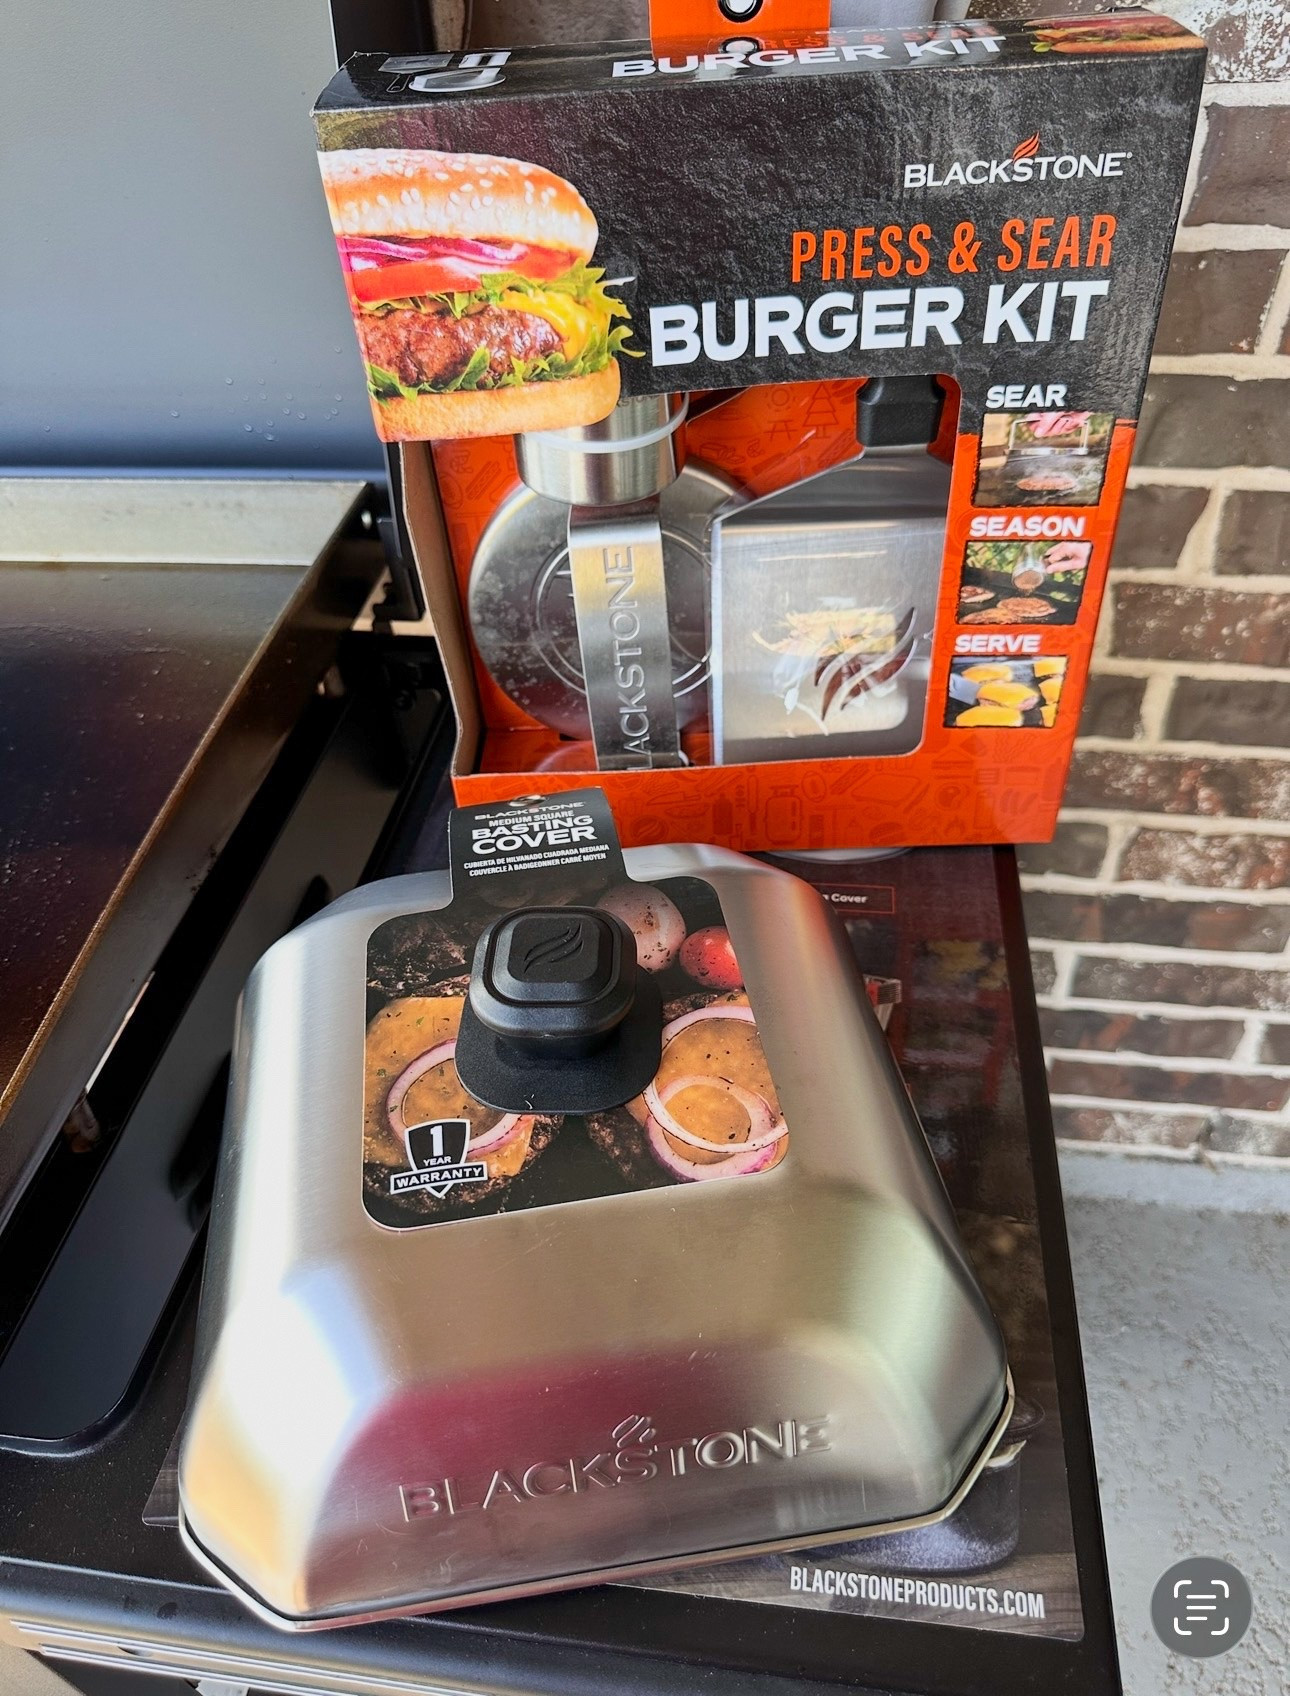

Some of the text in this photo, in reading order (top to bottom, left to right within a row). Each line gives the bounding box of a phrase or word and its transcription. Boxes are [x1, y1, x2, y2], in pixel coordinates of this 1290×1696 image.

[611, 35, 1007, 78] BURGER KIT
[903, 151, 1128, 189] BLACKSTONE
[791, 213, 1118, 283] PRESS & SEAR
[647, 279, 1111, 367] BURGER KIT
[985, 384, 1068, 409] SEAR
[969, 515, 1086, 538] SEASON
[954, 633, 1042, 653] SERVE
[602, 545, 653, 770] LACKSTONE
[474, 801, 584, 821] BLACKSTONE
[488, 810, 575, 828] MEDIUM SQUARE
[471, 814, 594, 840] BASTING
[471, 826, 598, 855] COVER
[463, 859, 496, 869] CUBIERTA
[505, 852, 543, 864] HILVANADO
[543, 849, 579, 858] CUADRADA
[579, 844, 610, 854] MEDIANA
[469, 866, 508, 877] COUVERCLE
[513, 859, 561, 871] BADIGEONNER
[560, 855, 582, 865] CARRÉ
[583, 853, 607, 862] MOYEN
[831, 893, 869, 904] Cover
[430, 1124, 444, 1157] 1
[423, 1155, 452, 1167] YEAR
[395, 1167, 482, 1189] WARRANTY
[398, 1414, 834, 1523] BLACKSTONE
[789, 1565, 1047, 1619] BLACKSTONEPRODUCTS.COM
